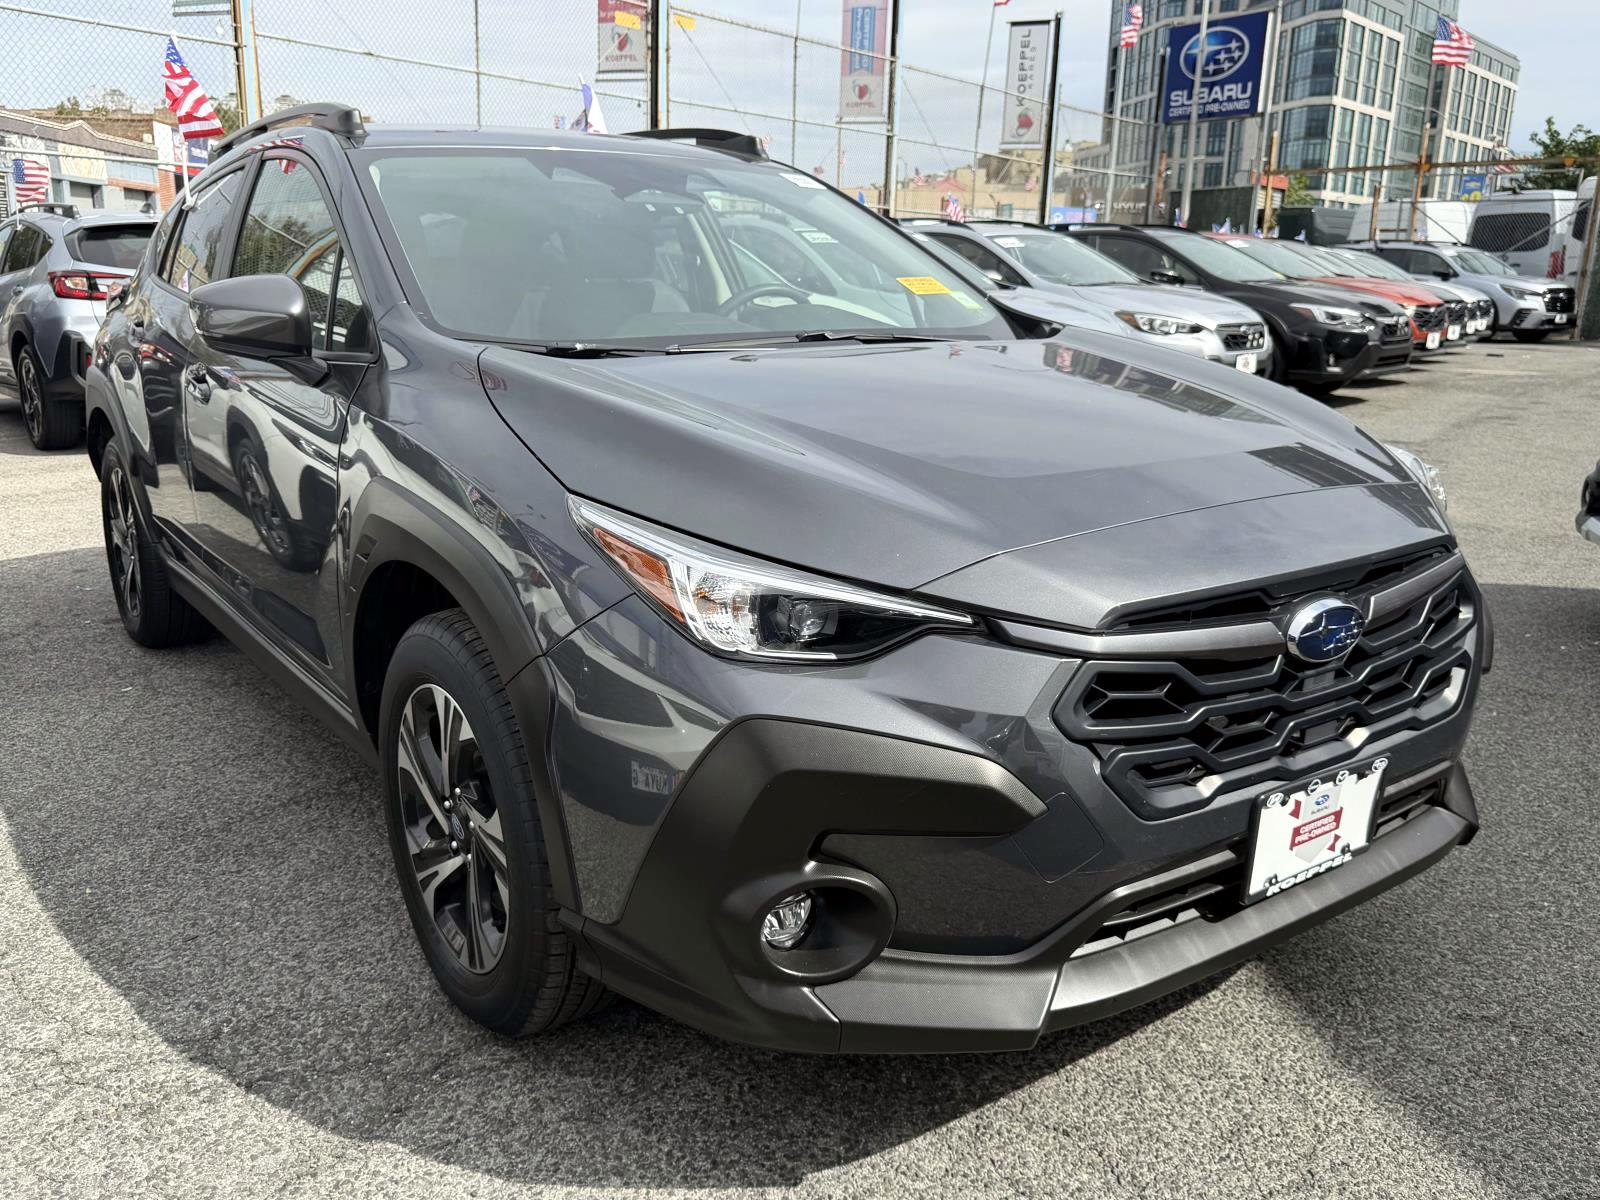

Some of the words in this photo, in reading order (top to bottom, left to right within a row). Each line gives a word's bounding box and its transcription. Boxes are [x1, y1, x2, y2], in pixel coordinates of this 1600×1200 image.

[1016, 29, 1032, 107] KOEPPEL
[1169, 81, 1252, 107] SUBARU
[1169, 104, 1204, 117] CERTIFD
[1205, 100, 1251, 114] PRE-OWNED
[1294, 821, 1337, 844] PRE-OWNED
[1300, 815, 1335, 834] CERTIFIED
[1266, 852, 1353, 897] KOEPPEL
